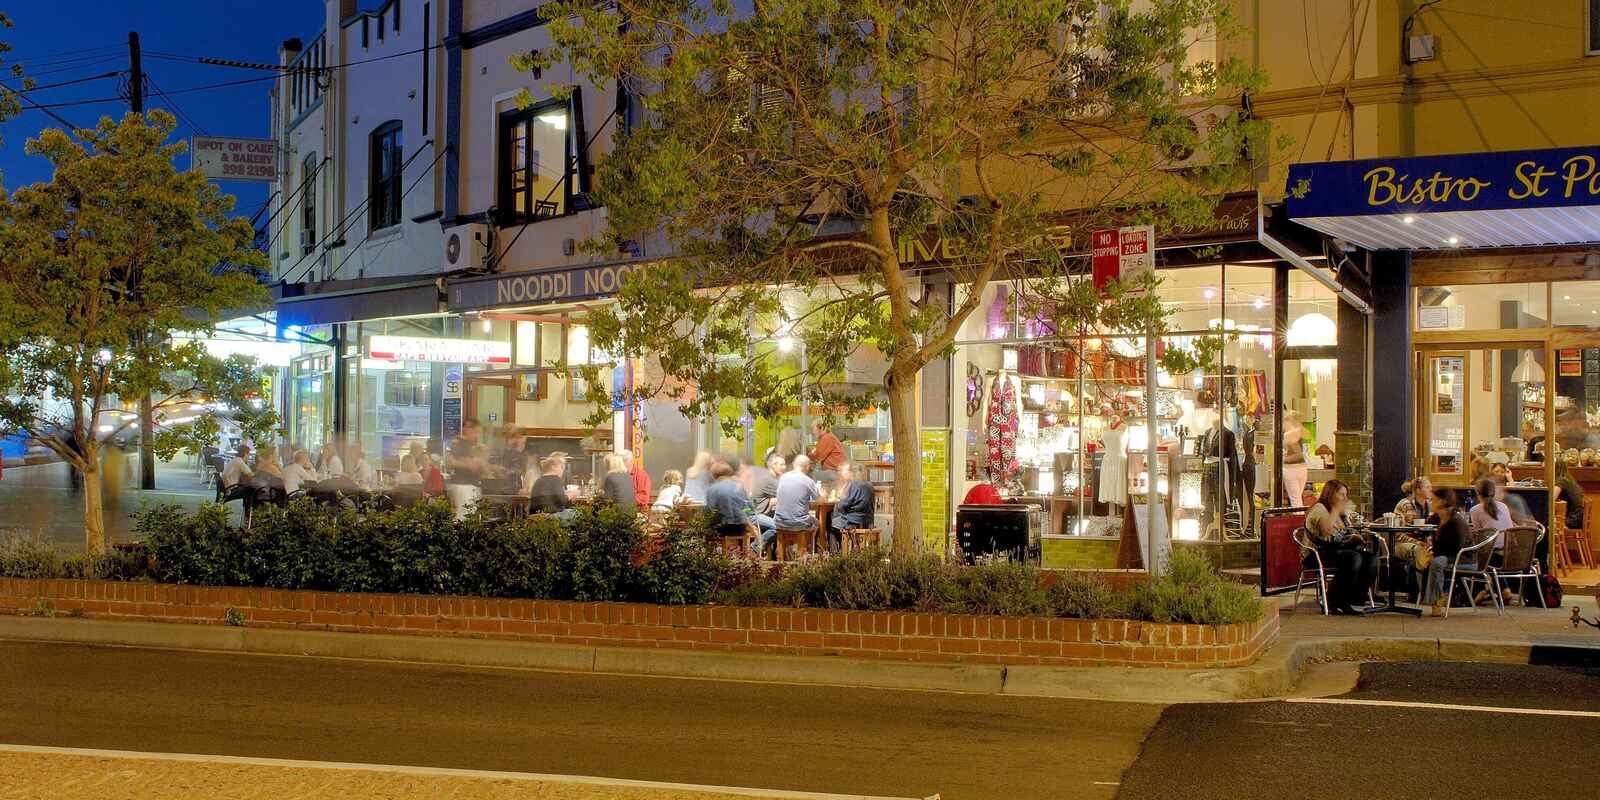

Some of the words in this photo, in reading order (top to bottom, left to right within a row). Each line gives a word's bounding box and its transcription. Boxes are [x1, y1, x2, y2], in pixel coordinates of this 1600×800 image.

[197, 141, 224, 151] SPOT
[228, 142, 242, 152] ON
[247, 143, 274, 153] CAKE
[222, 153, 229, 162] &
[232, 153, 273, 164] BAKERY
[1363, 166, 1491, 206] Bistro
[1508, 160, 1556, 200] St
[1099, 233, 1111, 245] NO
[1121, 231, 1147, 244] LOADING
[1093, 246, 1119, 258] STOPPING
[1124, 243, 1144, 255] ZONE
[497, 272, 571, 302] NOODDI
